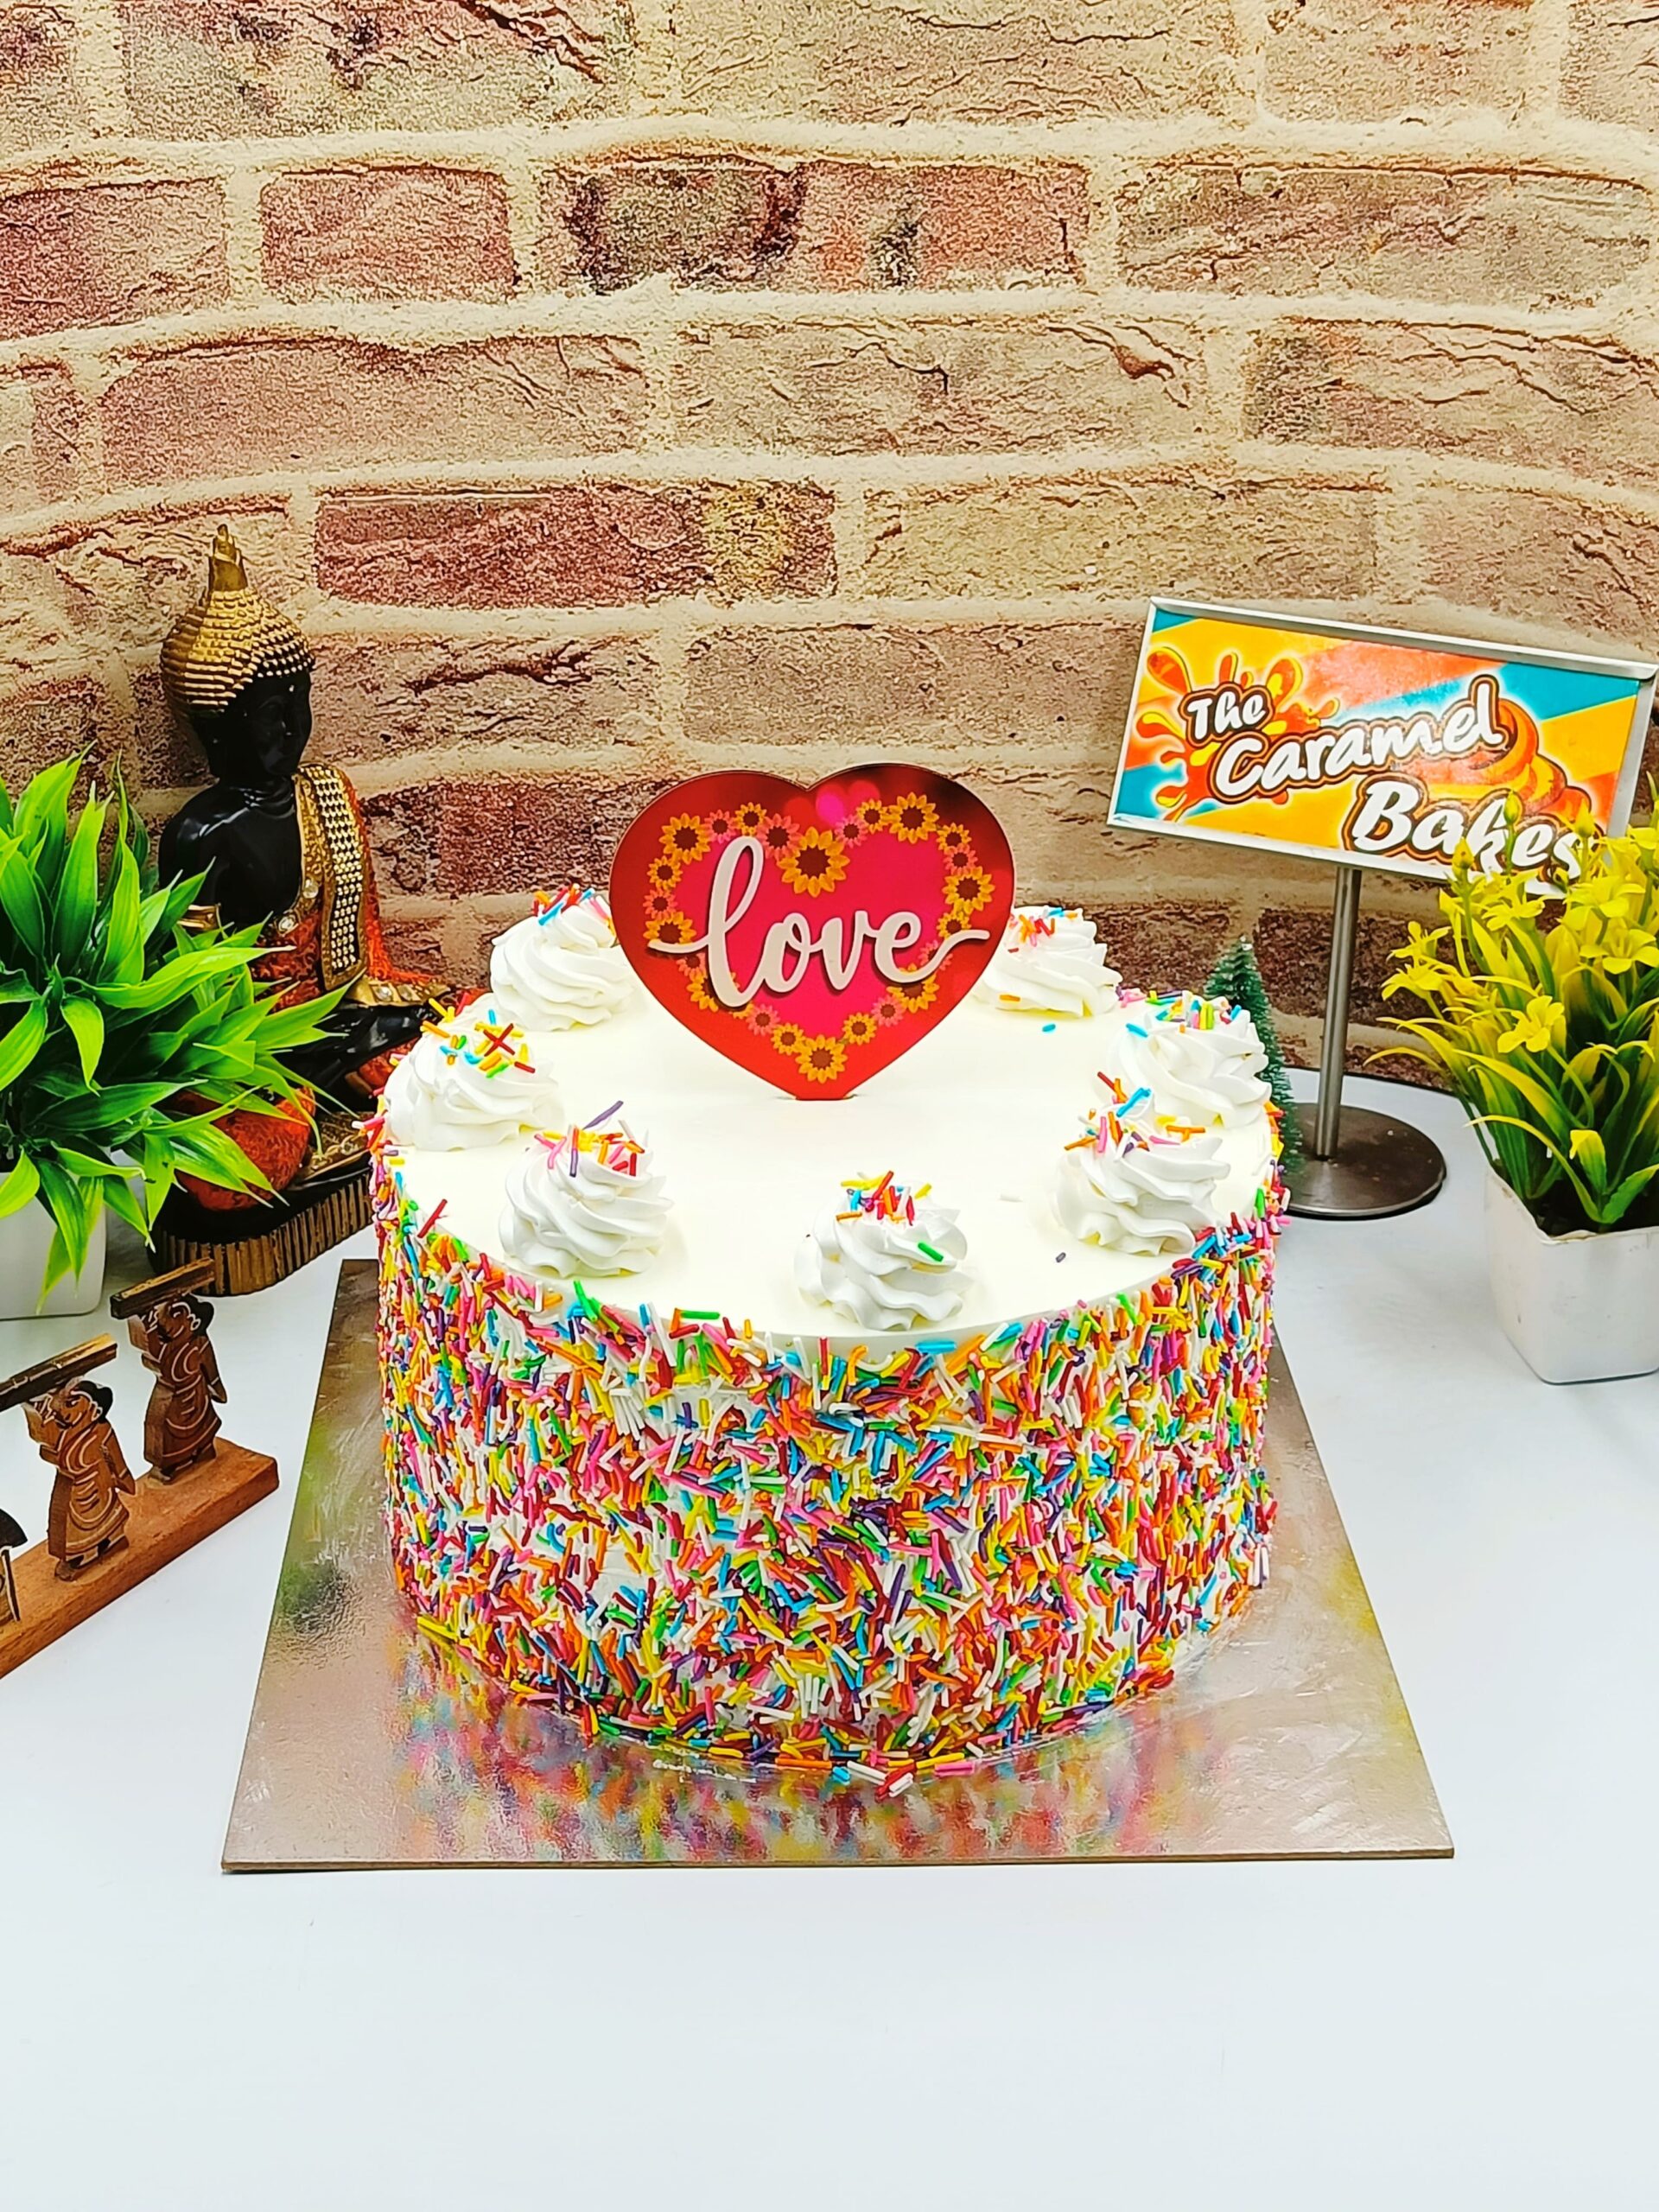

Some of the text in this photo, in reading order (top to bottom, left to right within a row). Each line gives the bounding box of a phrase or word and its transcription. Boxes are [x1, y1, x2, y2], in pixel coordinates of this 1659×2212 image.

[1185, 690, 1268, 741] The
[1215, 683, 1503, 797] Caramel
[1351, 779, 1583, 880] Bakes
[647, 836, 990, 1007] love
